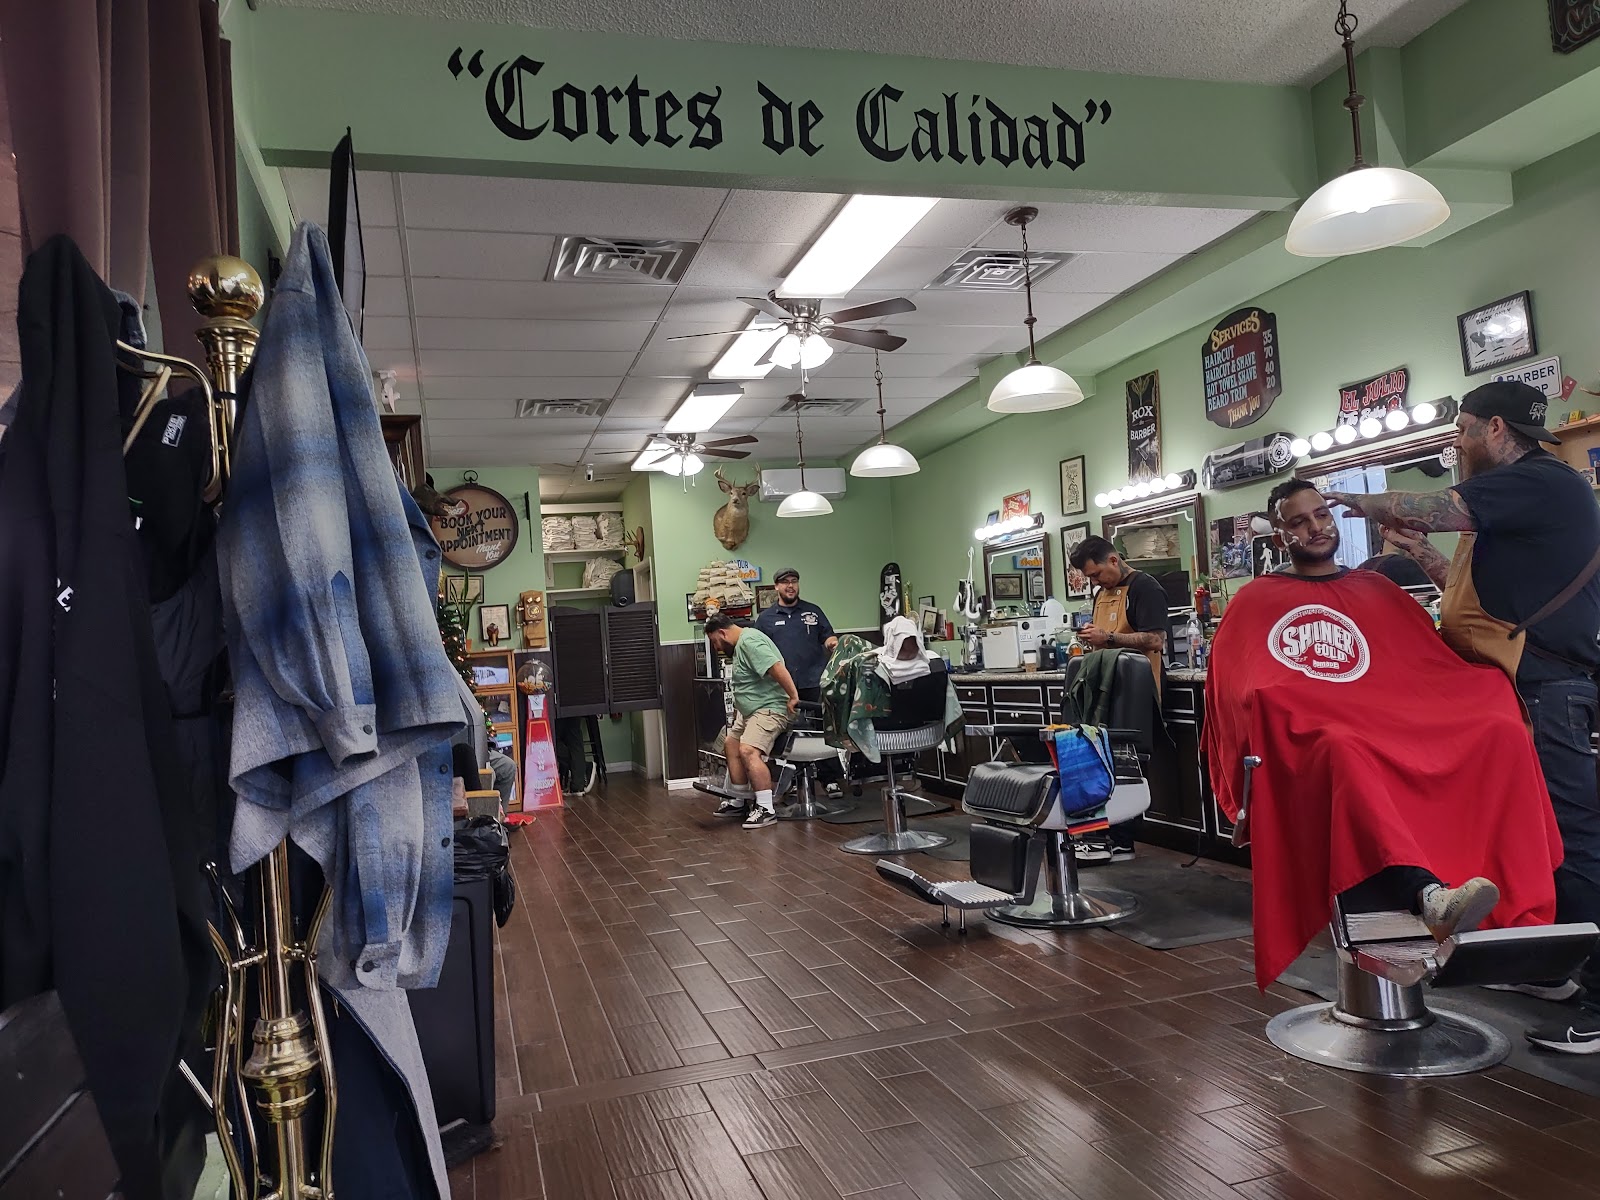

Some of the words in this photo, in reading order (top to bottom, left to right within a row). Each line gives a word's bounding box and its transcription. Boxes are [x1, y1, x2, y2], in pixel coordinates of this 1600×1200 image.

[757, 80, 824, 156] de
[1205, 344, 1234, 369] HAIRCUT
[1262, 329, 1273, 346] 35
[1211, 311, 1261, 352] SERVICES
[1205, 360, 1231, 384] HAIRCUT
[1231, 360, 1237, 372] &
[1236, 351, 1256, 371] SHAVE
[1264, 345, 1274, 358] 70
[1206, 382, 1218, 398] HOT
[1219, 375, 1238, 392] TOWEL
[1238, 366, 1258, 385] SHAVE
[1265, 360, 1275, 374] 40
[1207, 394, 1230, 412] BEARD
[1230, 385, 1248, 404] TRIM
[1266, 375, 1276, 389] 20
[1342, 390, 1360, 412] EL
[1362, 370, 1406, 406] JULIO
[1130, 423, 1156, 440] BARBER
[1131, 405, 1155, 423] ROX
[1227, 404, 1248, 428] THANK
[440, 512, 473, 529] BOOK
[476, 507, 507, 522] YOUR
[440, 528, 512, 553] APPOINTMENT
[476, 541, 502, 554] Thank
[1282, 620, 1355, 658] SHINER
[1314, 643, 1348, 662] GOLD
